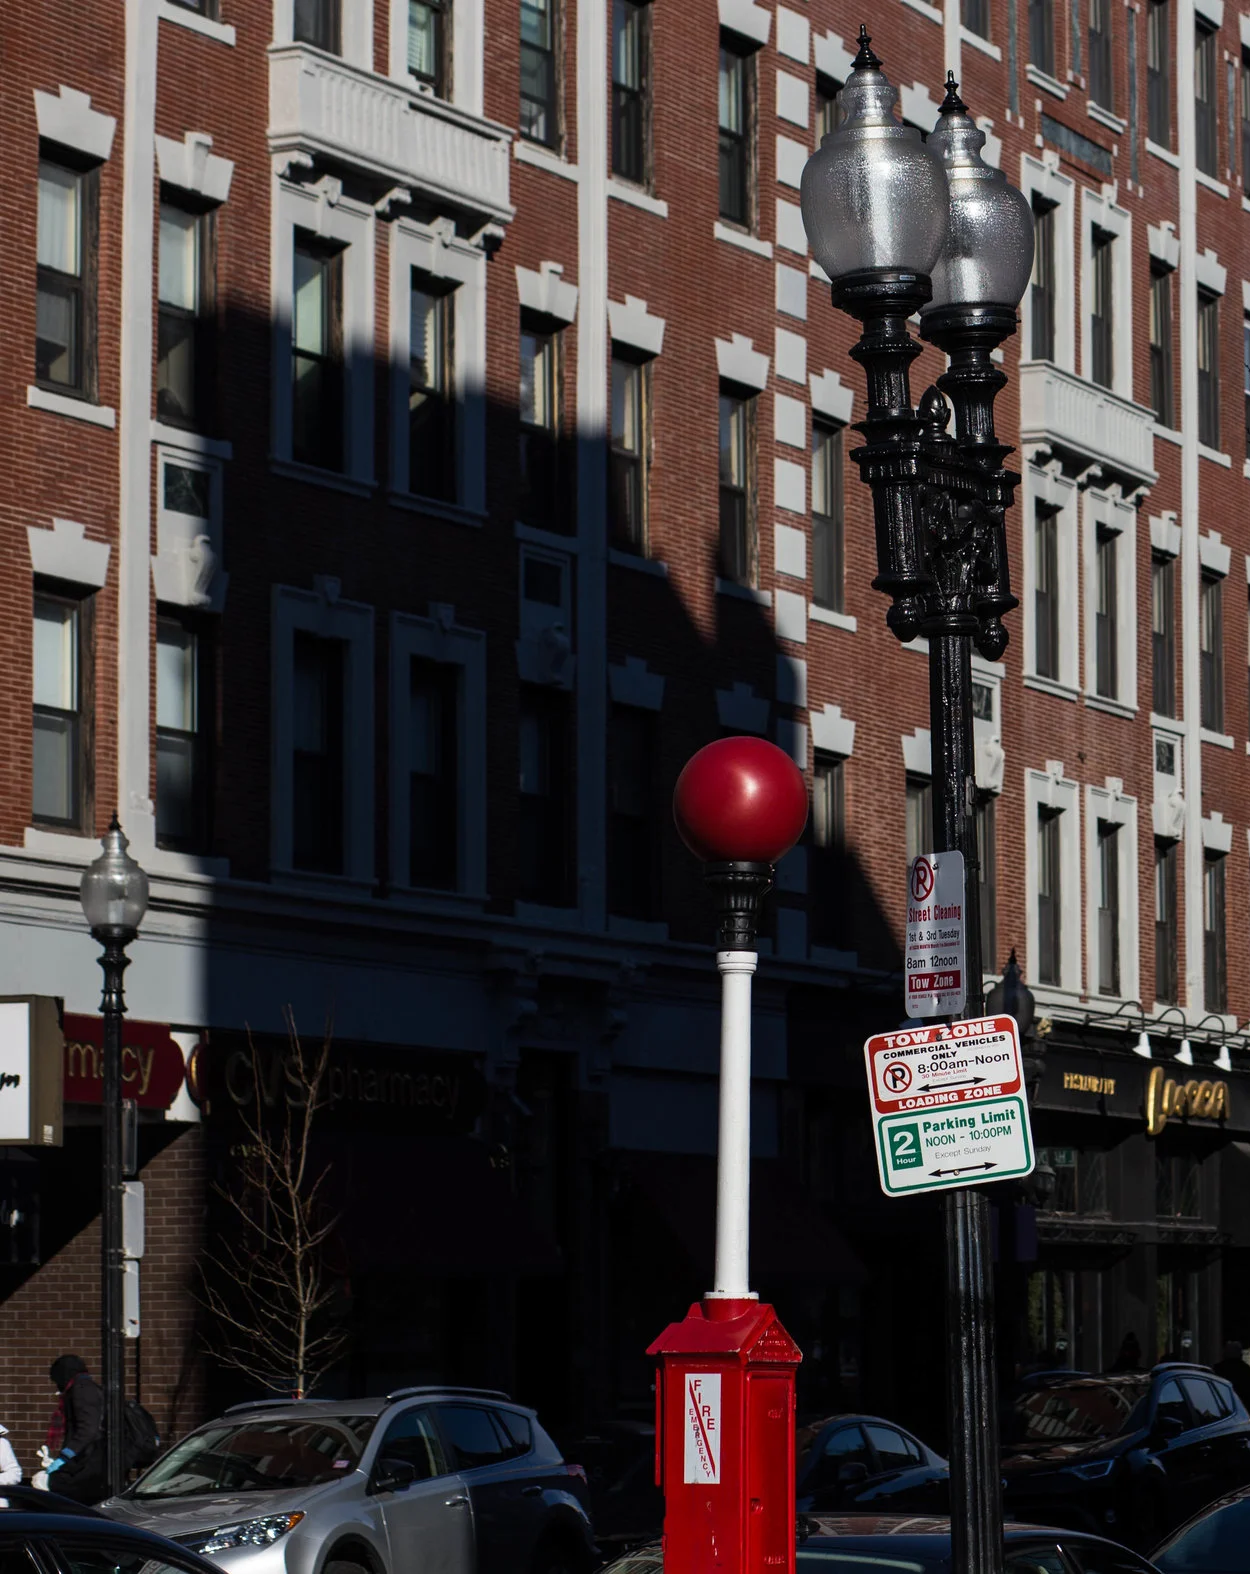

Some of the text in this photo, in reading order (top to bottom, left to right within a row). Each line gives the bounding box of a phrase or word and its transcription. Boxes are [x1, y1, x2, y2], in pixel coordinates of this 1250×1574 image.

[908, 903, 962, 923] Street Cleaning
[908, 928, 961, 942] 1st & 3rd Tuesday
[906, 955, 958, 969] 8am 12noon
[911, 974, 954, 990] Tow Zone
[883, 1020, 997, 1049] TOW ZONE
[883, 1043, 951, 1060] COMMERCIAL
[955, 1034, 1006, 1048] VEHICLES
[931, 1050, 958, 1061] ONLY
[327, 1058, 461, 1120] pharmacy
[898, 1084, 1002, 1110] LOADING ZONE
[922, 1109, 1016, 1133] Parking Limit
[893, 1131, 916, 1156] 2
[925, 1133, 956, 1148] NOON
[969, 1125, 1012, 1141] 10:00PM
[896, 1156, 917, 1165] Hour
[935, 1144, 992, 1160] Except Sunday
[693, 1379, 716, 1431] FIRE
[688, 1408, 712, 1478] EMERGENCY
